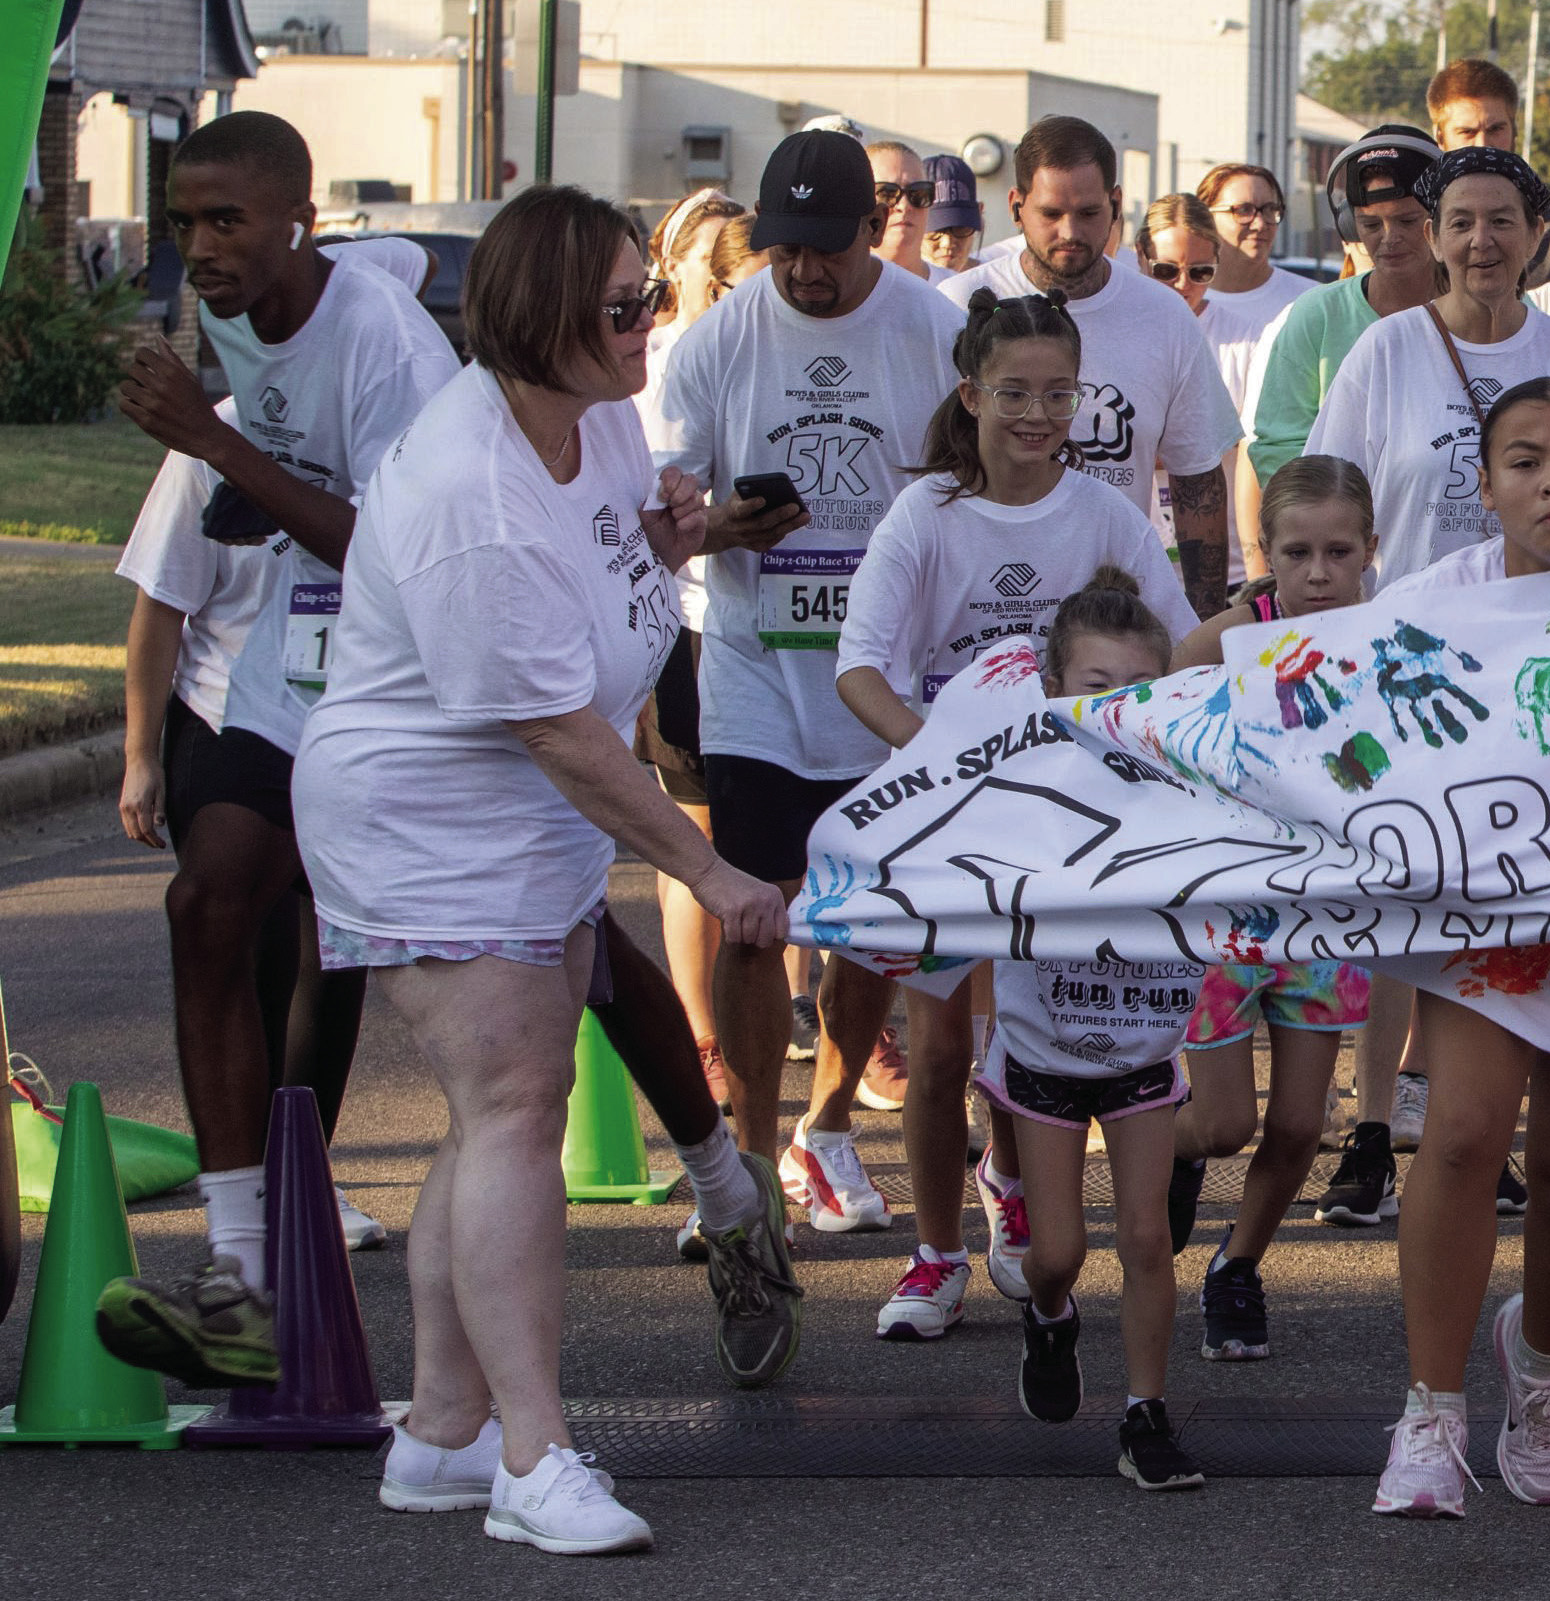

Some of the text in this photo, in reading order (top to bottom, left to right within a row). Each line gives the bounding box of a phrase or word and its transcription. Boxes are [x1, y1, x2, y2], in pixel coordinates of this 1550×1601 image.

[787, 434, 870, 497] 5K
[1426, 503, 1457, 517] FOR
[833, 516, 870, 531] RUN
[764, 555, 817, 567] Chip-2-Chip
[819, 556, 842, 566] Race
[792, 586, 849, 623] 545
[969, 598, 1061, 610] BOYS & GIRLS CLUBS
[1051, 974, 1116, 1010] fun
[1122, 986, 1196, 1013] run
[1059, 1013, 1181, 1029] FUTURES START HERE.
